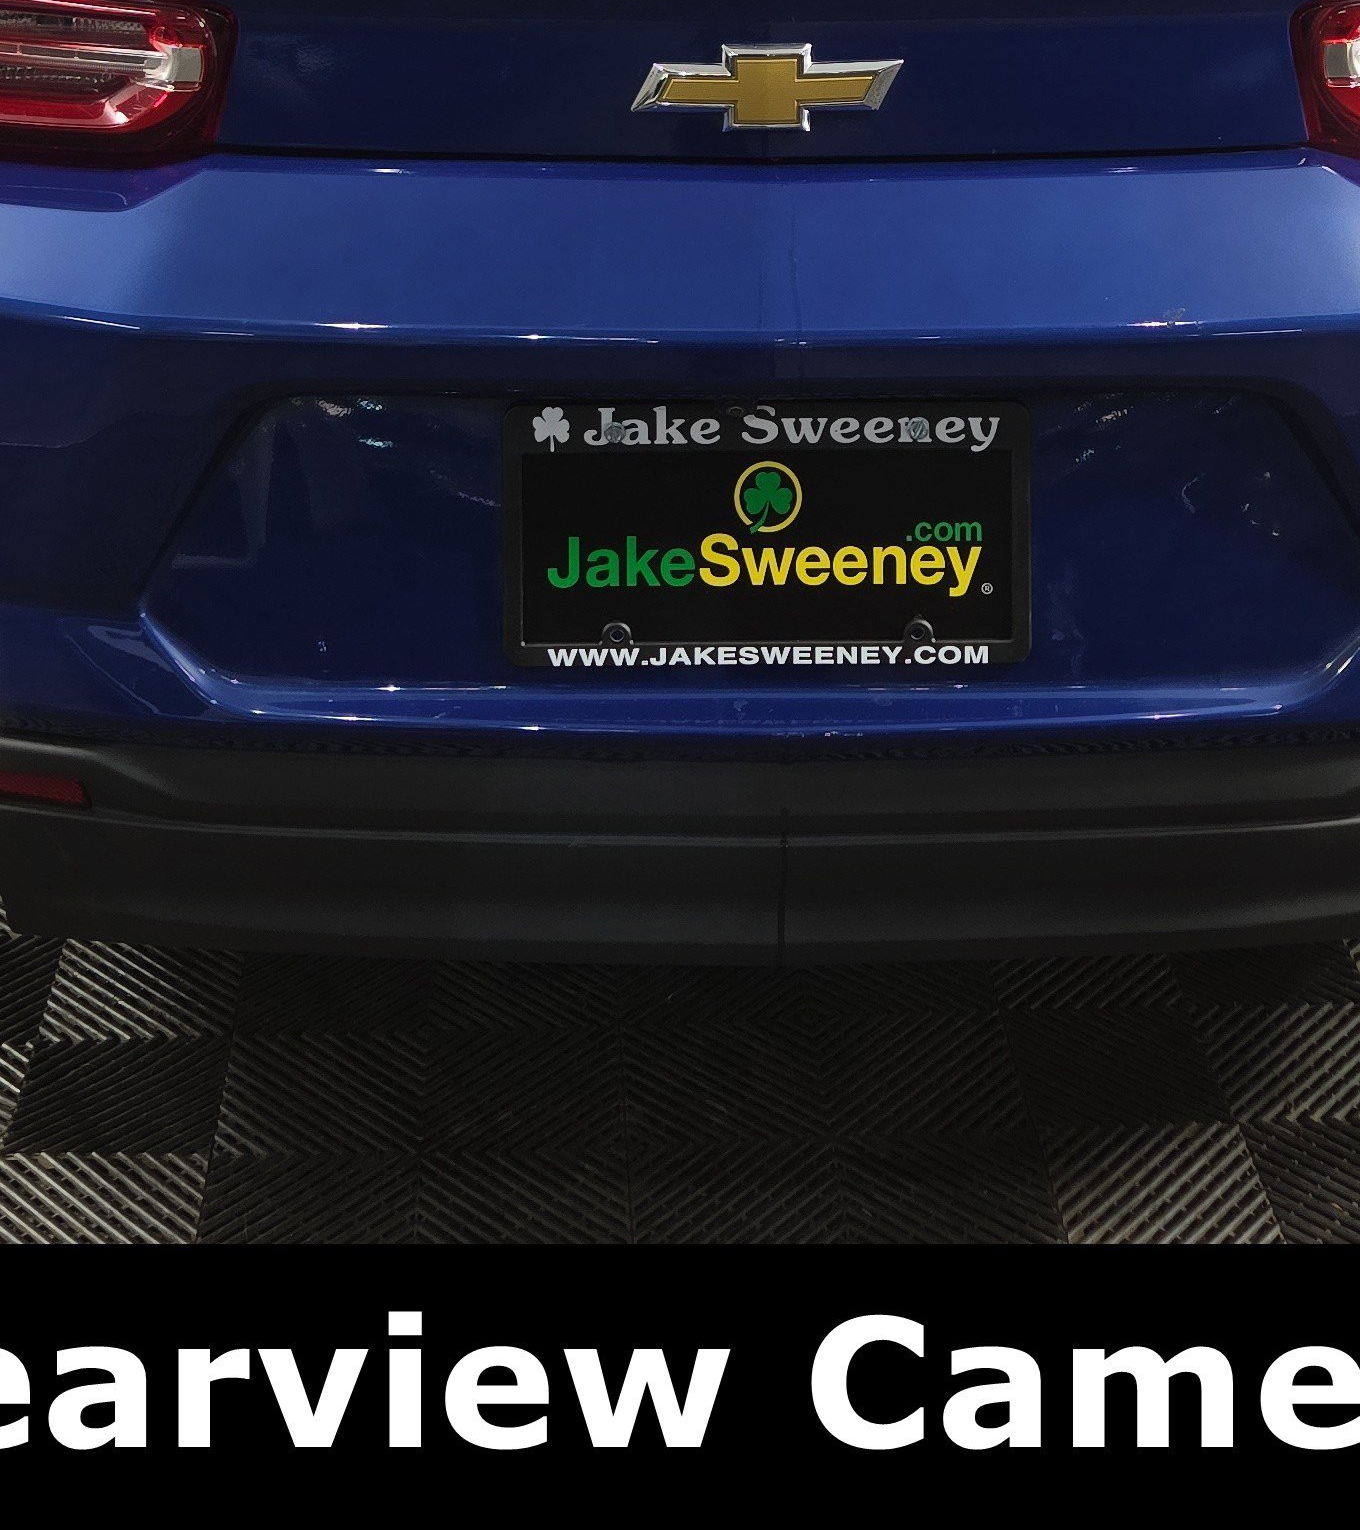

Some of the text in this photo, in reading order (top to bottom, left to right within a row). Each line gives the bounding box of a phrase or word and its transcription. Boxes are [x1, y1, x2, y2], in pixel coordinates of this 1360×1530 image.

[583, 406, 1000, 452] Jake Sweeney
[548, 646, 989, 667] WWW.JAKESWEENEY.COM
